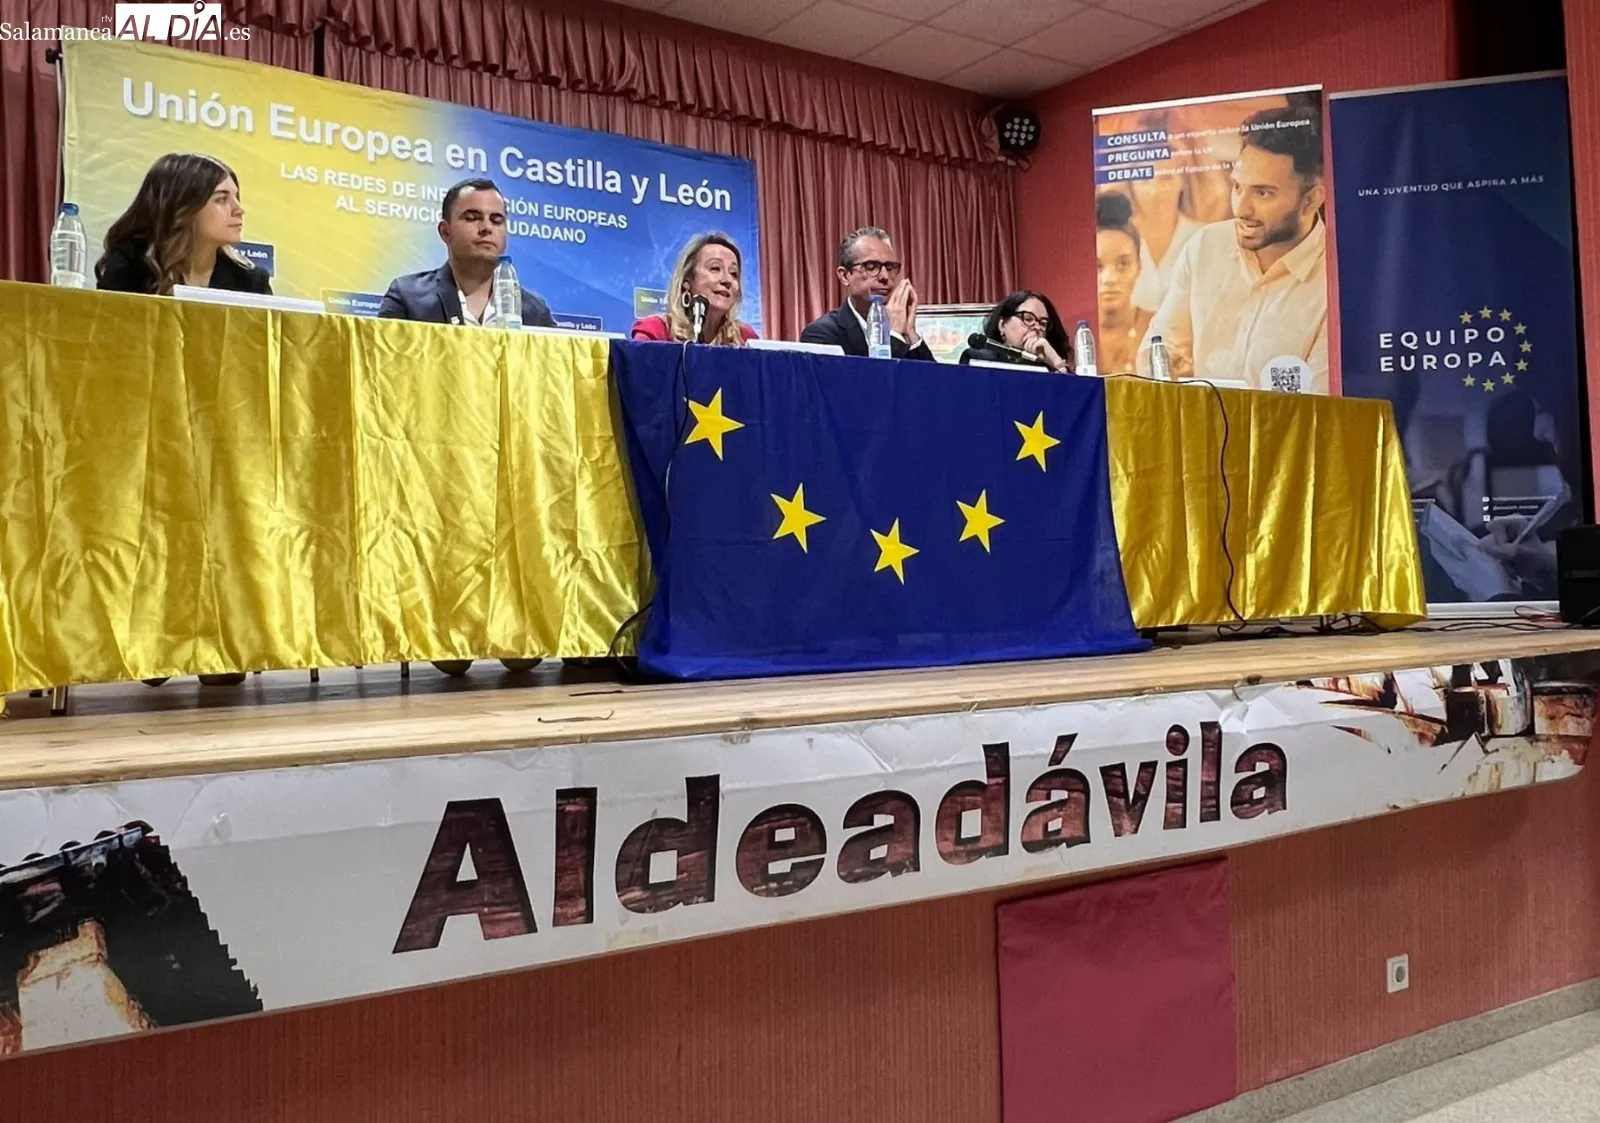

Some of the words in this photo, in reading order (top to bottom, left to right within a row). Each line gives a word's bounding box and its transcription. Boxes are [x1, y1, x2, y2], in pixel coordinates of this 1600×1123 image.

[122, 77, 254, 133] Unión
[269, 102, 434, 162] Europea
[445, 141, 488, 173] en
[500, 147, 623, 194] Castilla
[631, 175, 650, 205] y
[659, 173, 732, 212] León
[1107, 130, 1167, 147] CONSULTA
[1250, 122, 1275, 131] Unión
[1276, 119, 1311, 129] Europea
[1107, 148, 1170, 164] PREGUNTA
[1108, 166, 1153, 181] DEBATE
[280, 162, 319, 182] LAS
[324, 169, 388, 194] REDES
[392, 180, 418, 199] DE
[543, 204, 628, 230] EUROPEAS
[1358, 188, 1380, 197] UNA
[1383, 184, 1438, 195] JUVENTUD
[1441, 181, 1464, 191] QUE
[1467, 178, 1507, 189] ASPIRA
[1510, 177, 1518, 185] A
[1521, 174, 1545, 184] MÁS
[335, 195, 361, 212] AL
[1379, 326, 1506, 350] EQUIPO
[1379, 350, 1507, 373] EUROPA
[392, 721, 1289, 955] Aldeadávila
